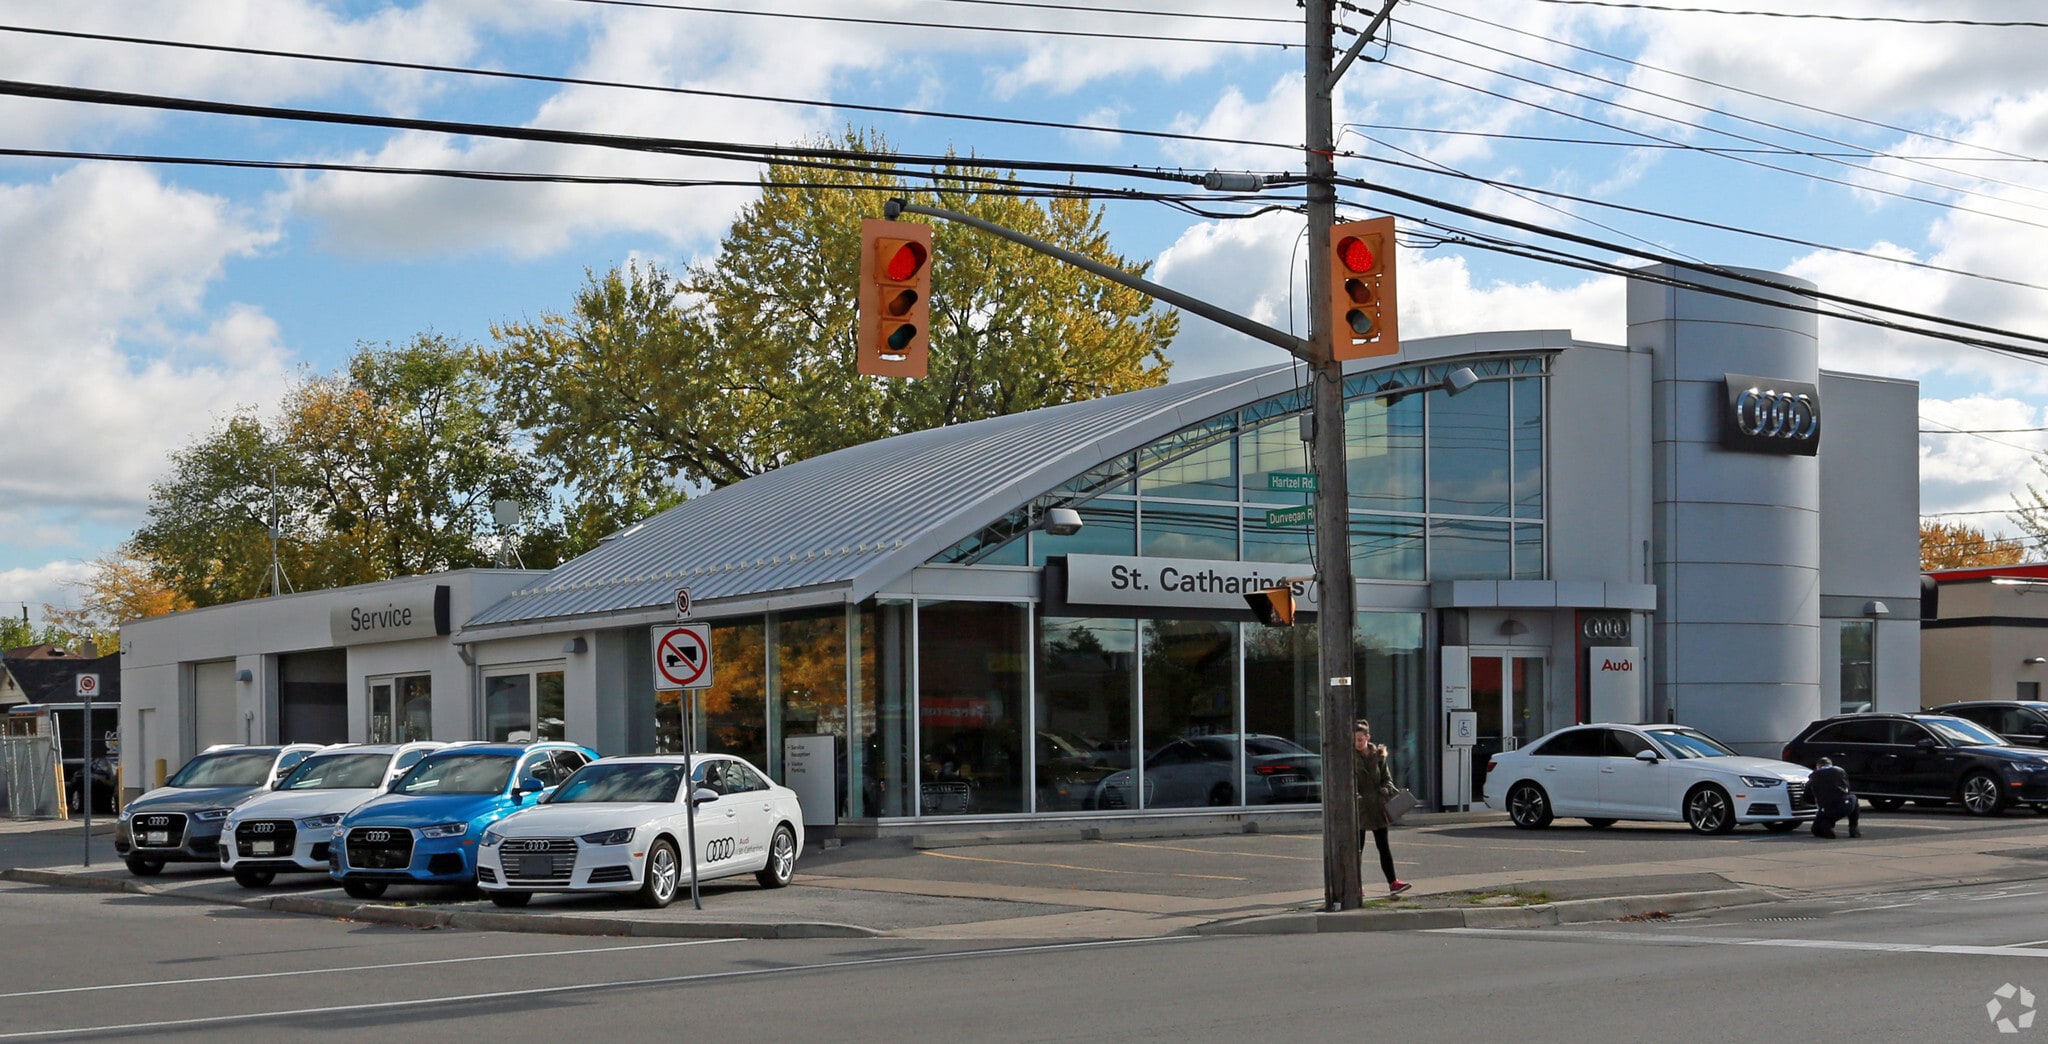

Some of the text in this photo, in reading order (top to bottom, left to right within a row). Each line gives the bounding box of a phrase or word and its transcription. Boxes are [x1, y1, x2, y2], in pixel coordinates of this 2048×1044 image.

[1272, 476, 1316, 489] Hartzel Rd.
[1270, 512, 1306, 524] Dunvegan
[1111, 565, 1149, 591] St.
[351, 603, 412, 632] Service
[1601, 658, 1633, 671] Audi
